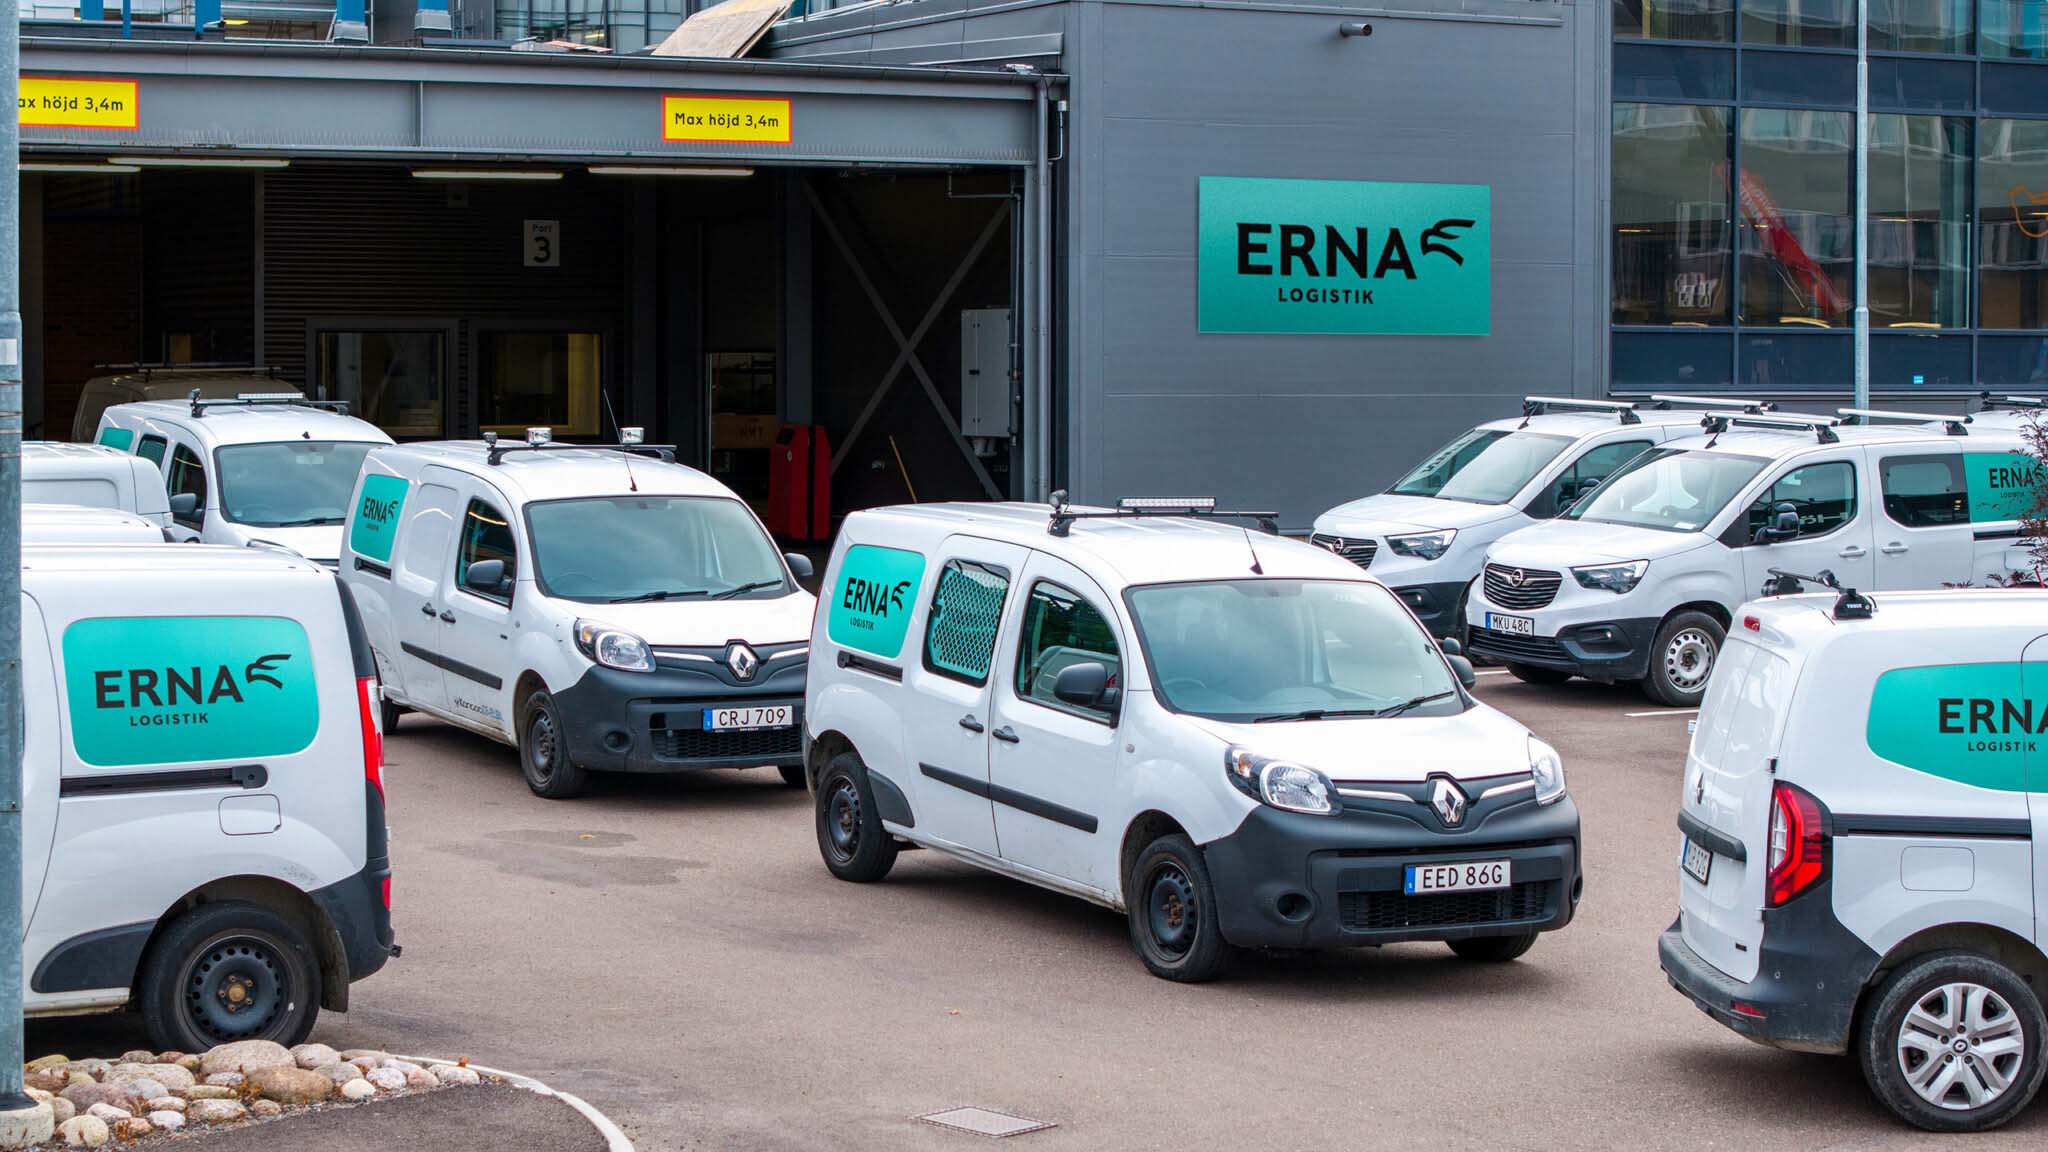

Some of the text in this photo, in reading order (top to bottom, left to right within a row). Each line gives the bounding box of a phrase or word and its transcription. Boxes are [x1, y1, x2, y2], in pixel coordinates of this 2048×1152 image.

[18, 95, 124, 113] ax höjd 3,4m
[674, 112, 779, 130] Max höjd 3,4m
[533, 236, 551, 263] 3
[1236, 222, 1417, 280] ERNA
[1277, 287, 1374, 305] LOGISTIK
[1988, 467, 2034, 489] ERNA
[362, 496, 388, 525] ERNA
[843, 576, 889, 619] ERNA
[1492, 615, 1529, 633] MKU 48C
[95, 664, 245, 709] ERNA
[129, 711, 208, 727] LOGISTIK
[719, 707, 786, 727] CRJ 709
[1967, 740, 2037, 752] LOGISTIK
[1422, 864, 1503, 889] EED 86G
